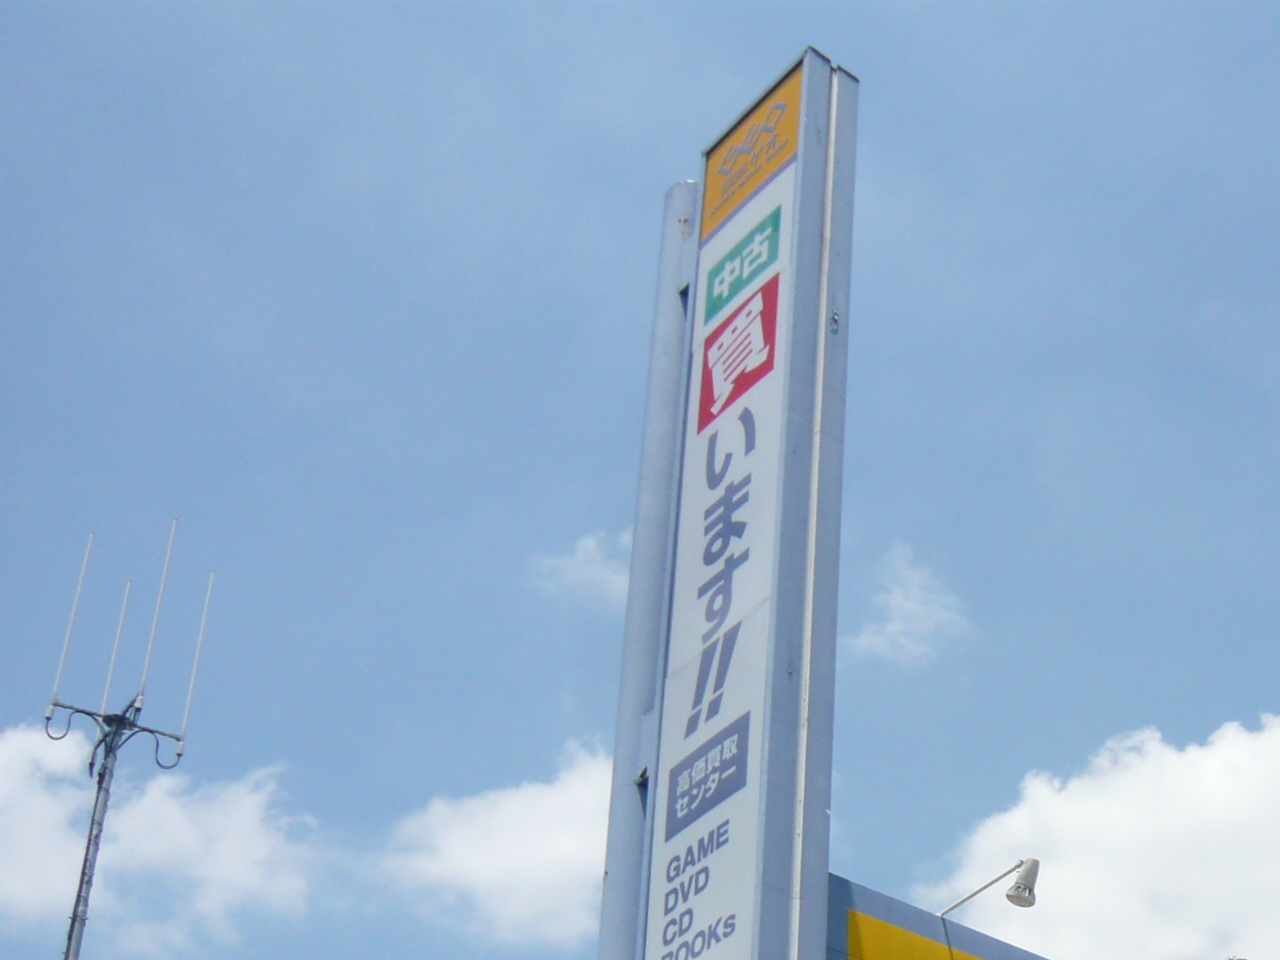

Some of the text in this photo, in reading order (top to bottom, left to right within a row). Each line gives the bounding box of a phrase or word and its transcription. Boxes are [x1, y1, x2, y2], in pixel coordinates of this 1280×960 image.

[713, 227, 773, 299] 中古
[676, 765, 737, 818] センター
[666, 819, 730, 884] GAME
[664, 866, 710, 917] DVD
[662, 908, 694, 947] CD
